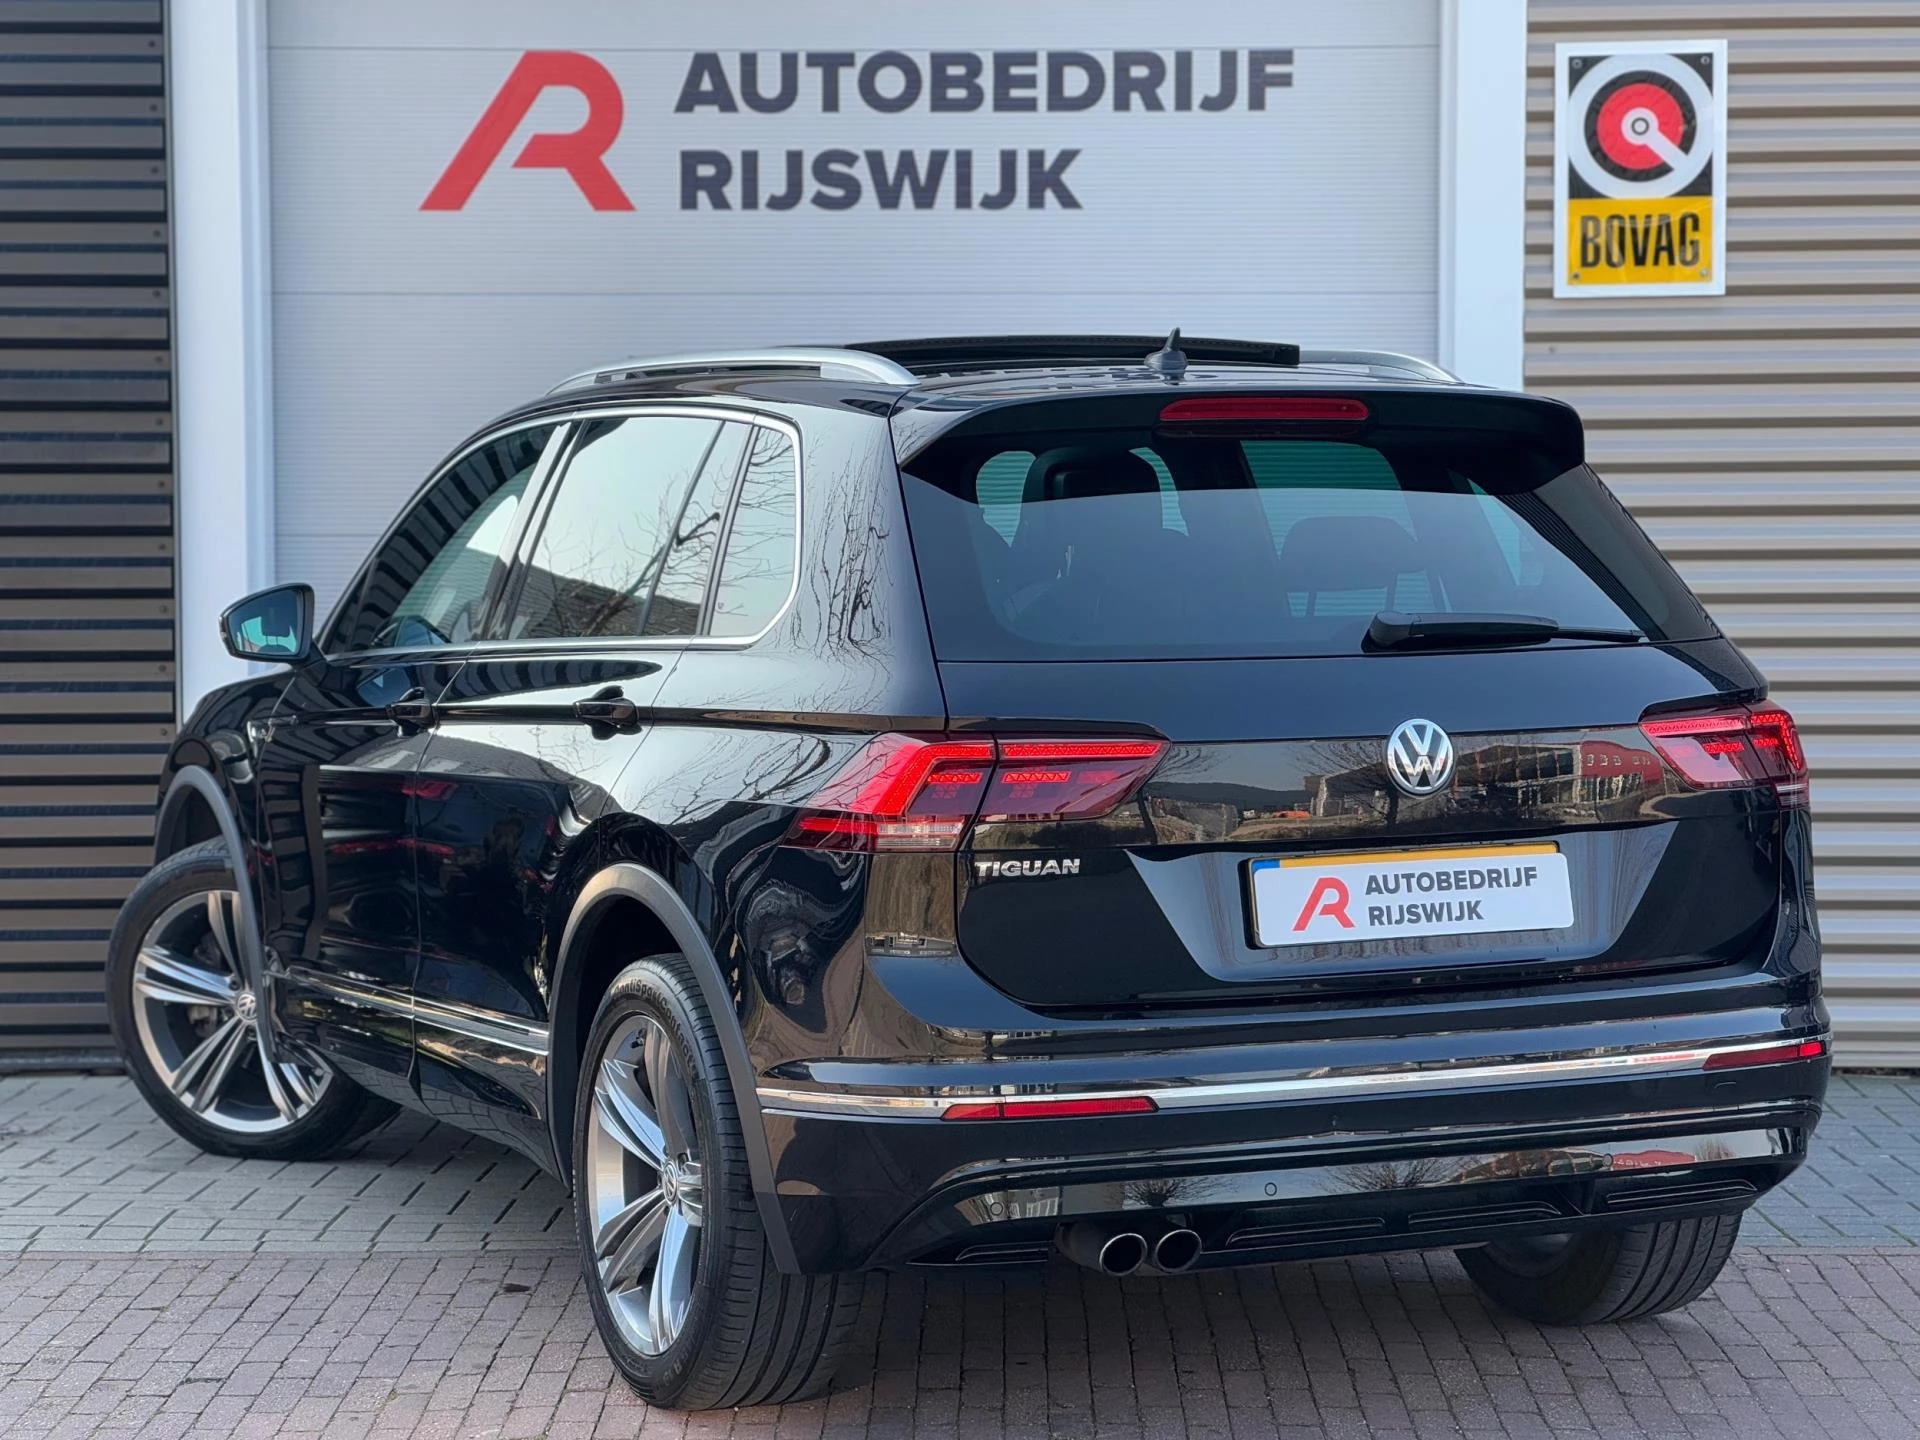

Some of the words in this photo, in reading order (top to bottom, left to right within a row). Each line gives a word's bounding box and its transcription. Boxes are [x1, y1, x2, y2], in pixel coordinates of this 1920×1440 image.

[675, 49, 1293, 113] AUTOBEDRIJF
[680, 149, 1083, 210] RIJSWIJK
[1580, 212, 1700, 269] BOVAG
[974, 858, 1081, 877] TIGUAN
[1365, 867, 1538, 896] AUTOBEDRIJF
[1368, 900, 1484, 927] RIJSWIJK
